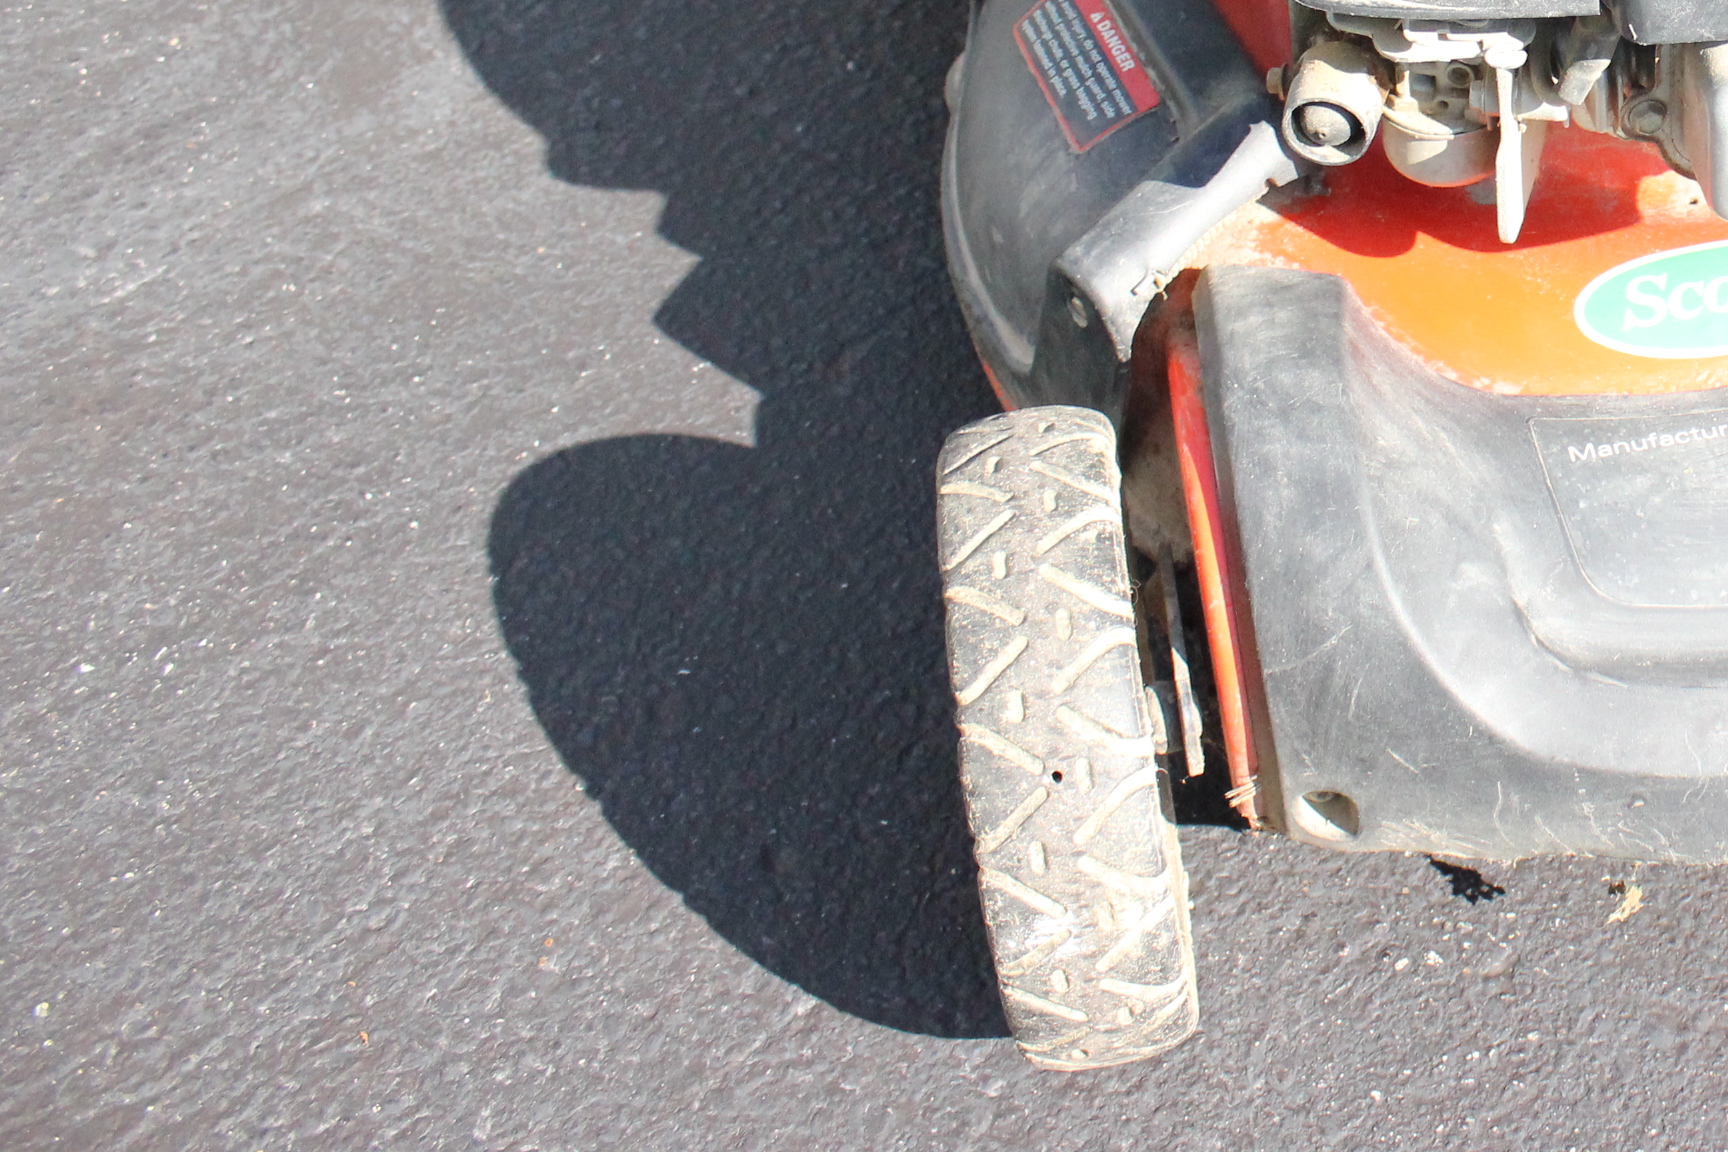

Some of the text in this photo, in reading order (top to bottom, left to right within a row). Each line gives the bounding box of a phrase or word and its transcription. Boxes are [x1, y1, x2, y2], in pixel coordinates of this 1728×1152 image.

[1032, 9, 1054, 41] discharge
[1032, 38, 1054, 71] fastened
[1046, 66, 1057, 78] in
[1044, 0, 1116, 119] without protective mulch guard, side
[1082, 39, 1094, 51] do
[1088, 48, 1103, 64] not
[1096, 19, 1136, 72] DANGER
[1059, 59, 1070, 69] or
[1062, 67, 1081, 90] grass
[1095, 61, 1118, 90] operate
[1075, 86, 1098, 121] bagging
[1111, 88, 1133, 116] mower
